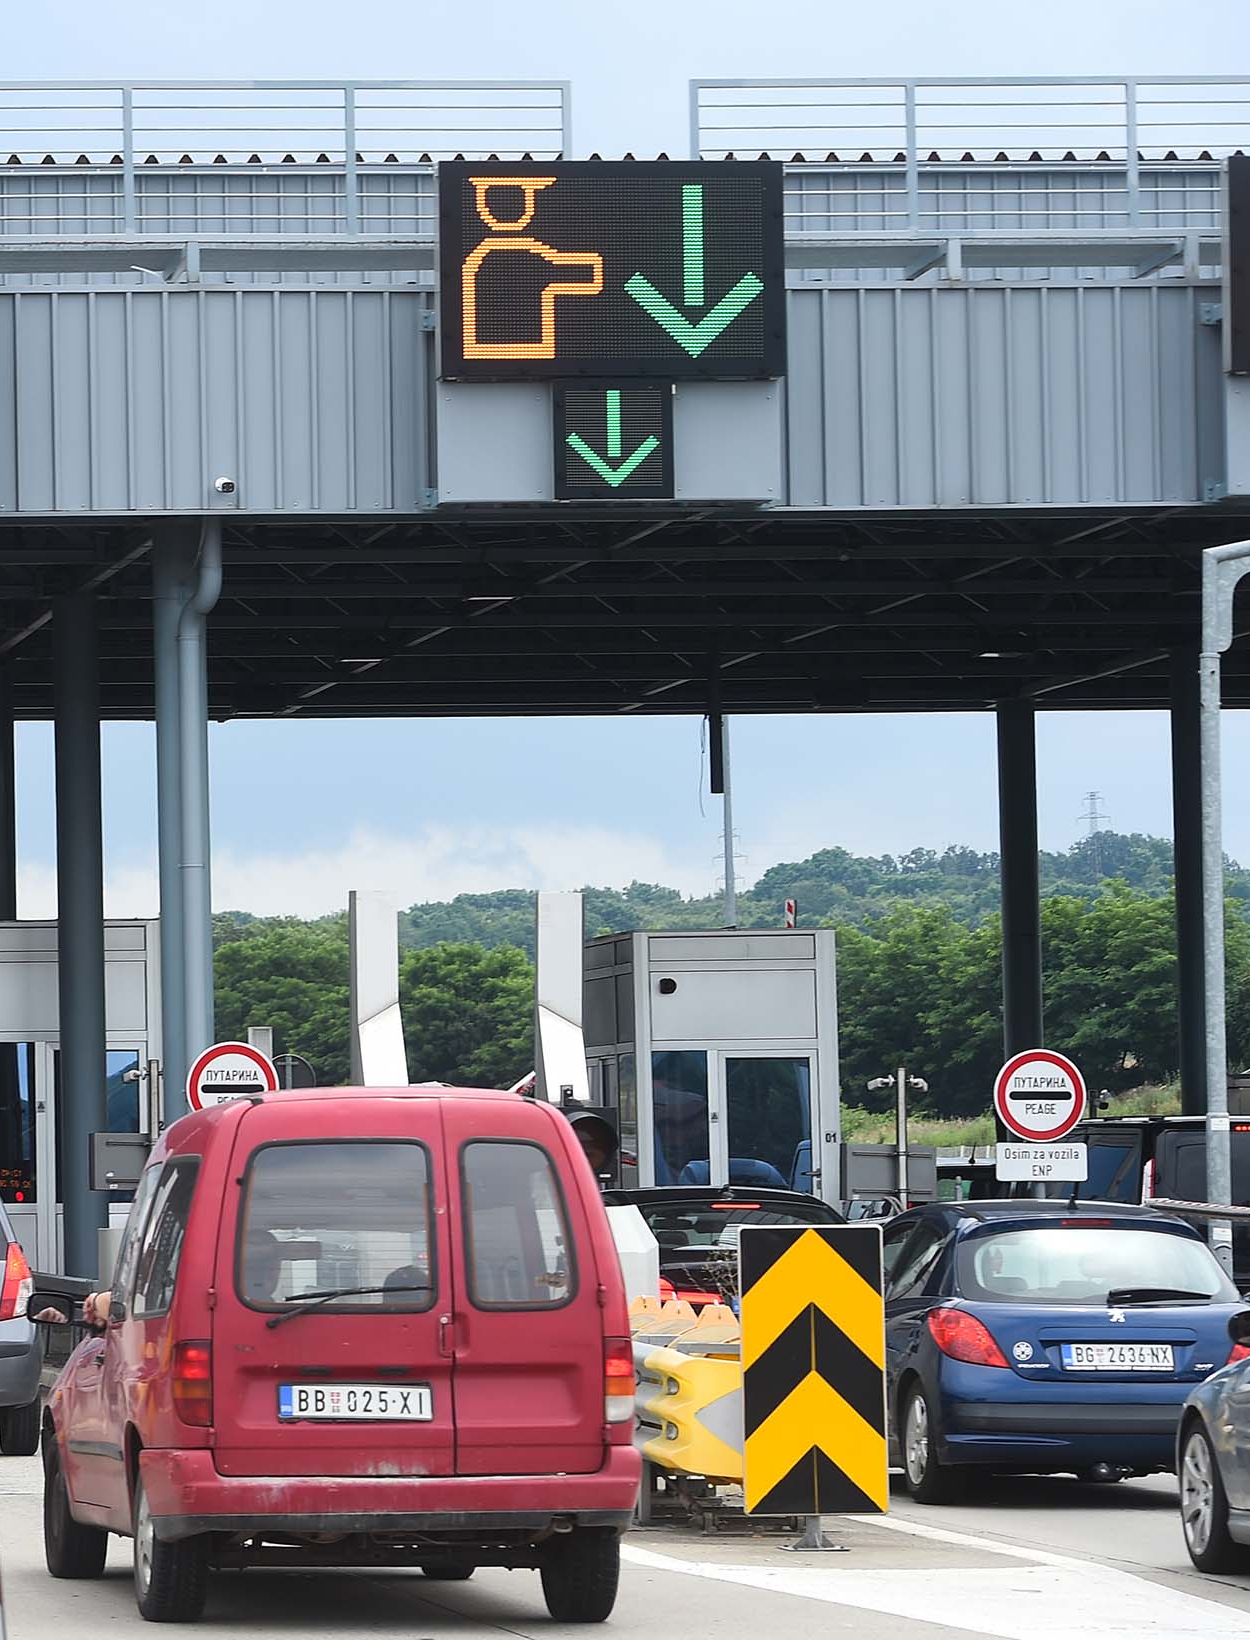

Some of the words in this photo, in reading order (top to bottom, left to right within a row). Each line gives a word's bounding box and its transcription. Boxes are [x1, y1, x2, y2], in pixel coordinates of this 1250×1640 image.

[206, 1070, 259, 1081] ПУТАРИНА
[1014, 1077, 1067, 1088] ПУТАРИНА
[1025, 1103, 1057, 1114] PEAGE
[825, 1132, 837, 1143] 01
[1004, 1148, 1031, 1160] Osim
[1033, 1151, 1045, 1160] za
[1048, 1148, 1080, 1160] vozila
[1031, 1165, 1053, 1176] ENP
[1075, 1346, 1095, 1363] BG
[298, 1390, 326, 1412] BB
